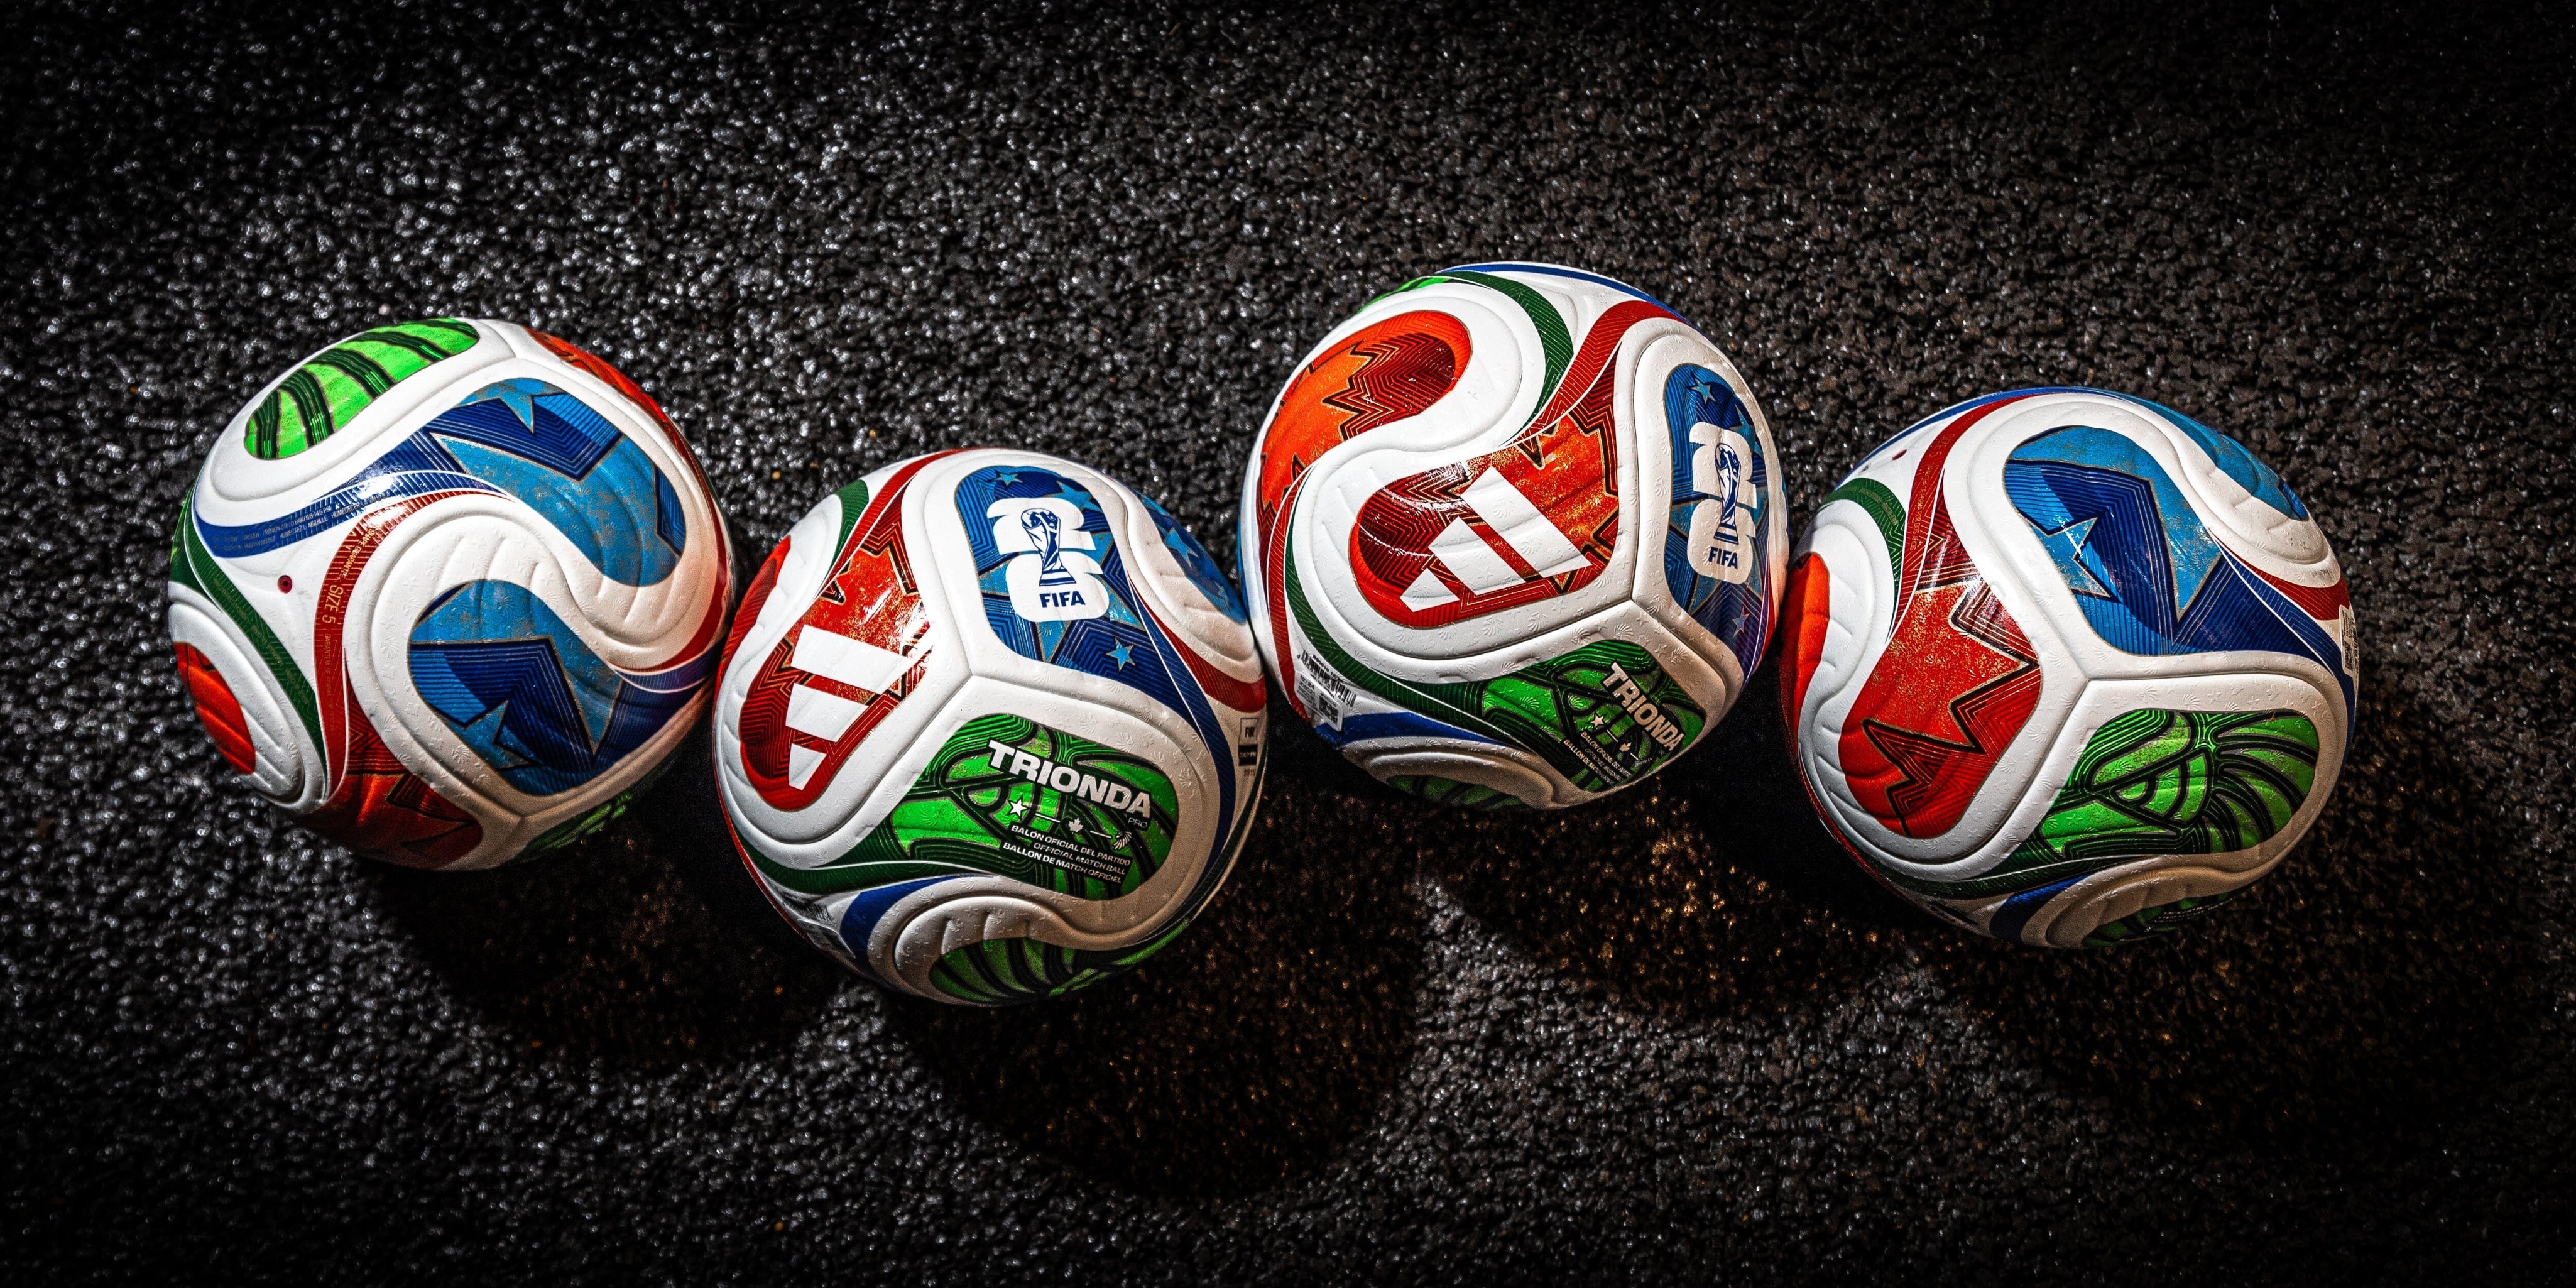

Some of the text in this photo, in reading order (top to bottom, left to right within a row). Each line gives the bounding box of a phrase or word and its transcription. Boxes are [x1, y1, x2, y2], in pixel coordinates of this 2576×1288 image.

[358, 528, 375, 547] SHAPE
[1708, 547, 1738, 569] FIFA
[322, 584, 344, 624] SIZE 5
[1039, 591, 1086, 608] FIFA
[1300, 674, 1315, 690] 12/24
[1603, 662, 1684, 751] TRIONDA
[988, 740, 1150, 819] TRIONDA
[1128, 817, 1148, 829] PRO
[1003, 842, 1122, 883] BALLON DE MATCH OFFICIEL
[1034, 843, 1125, 875] OFFICIAL MATCH BALL
[1045, 836, 1079, 852] OFICIAL
[1080, 846, 1096, 857] DEL
[1096, 852, 1130, 866] PARTIDO
